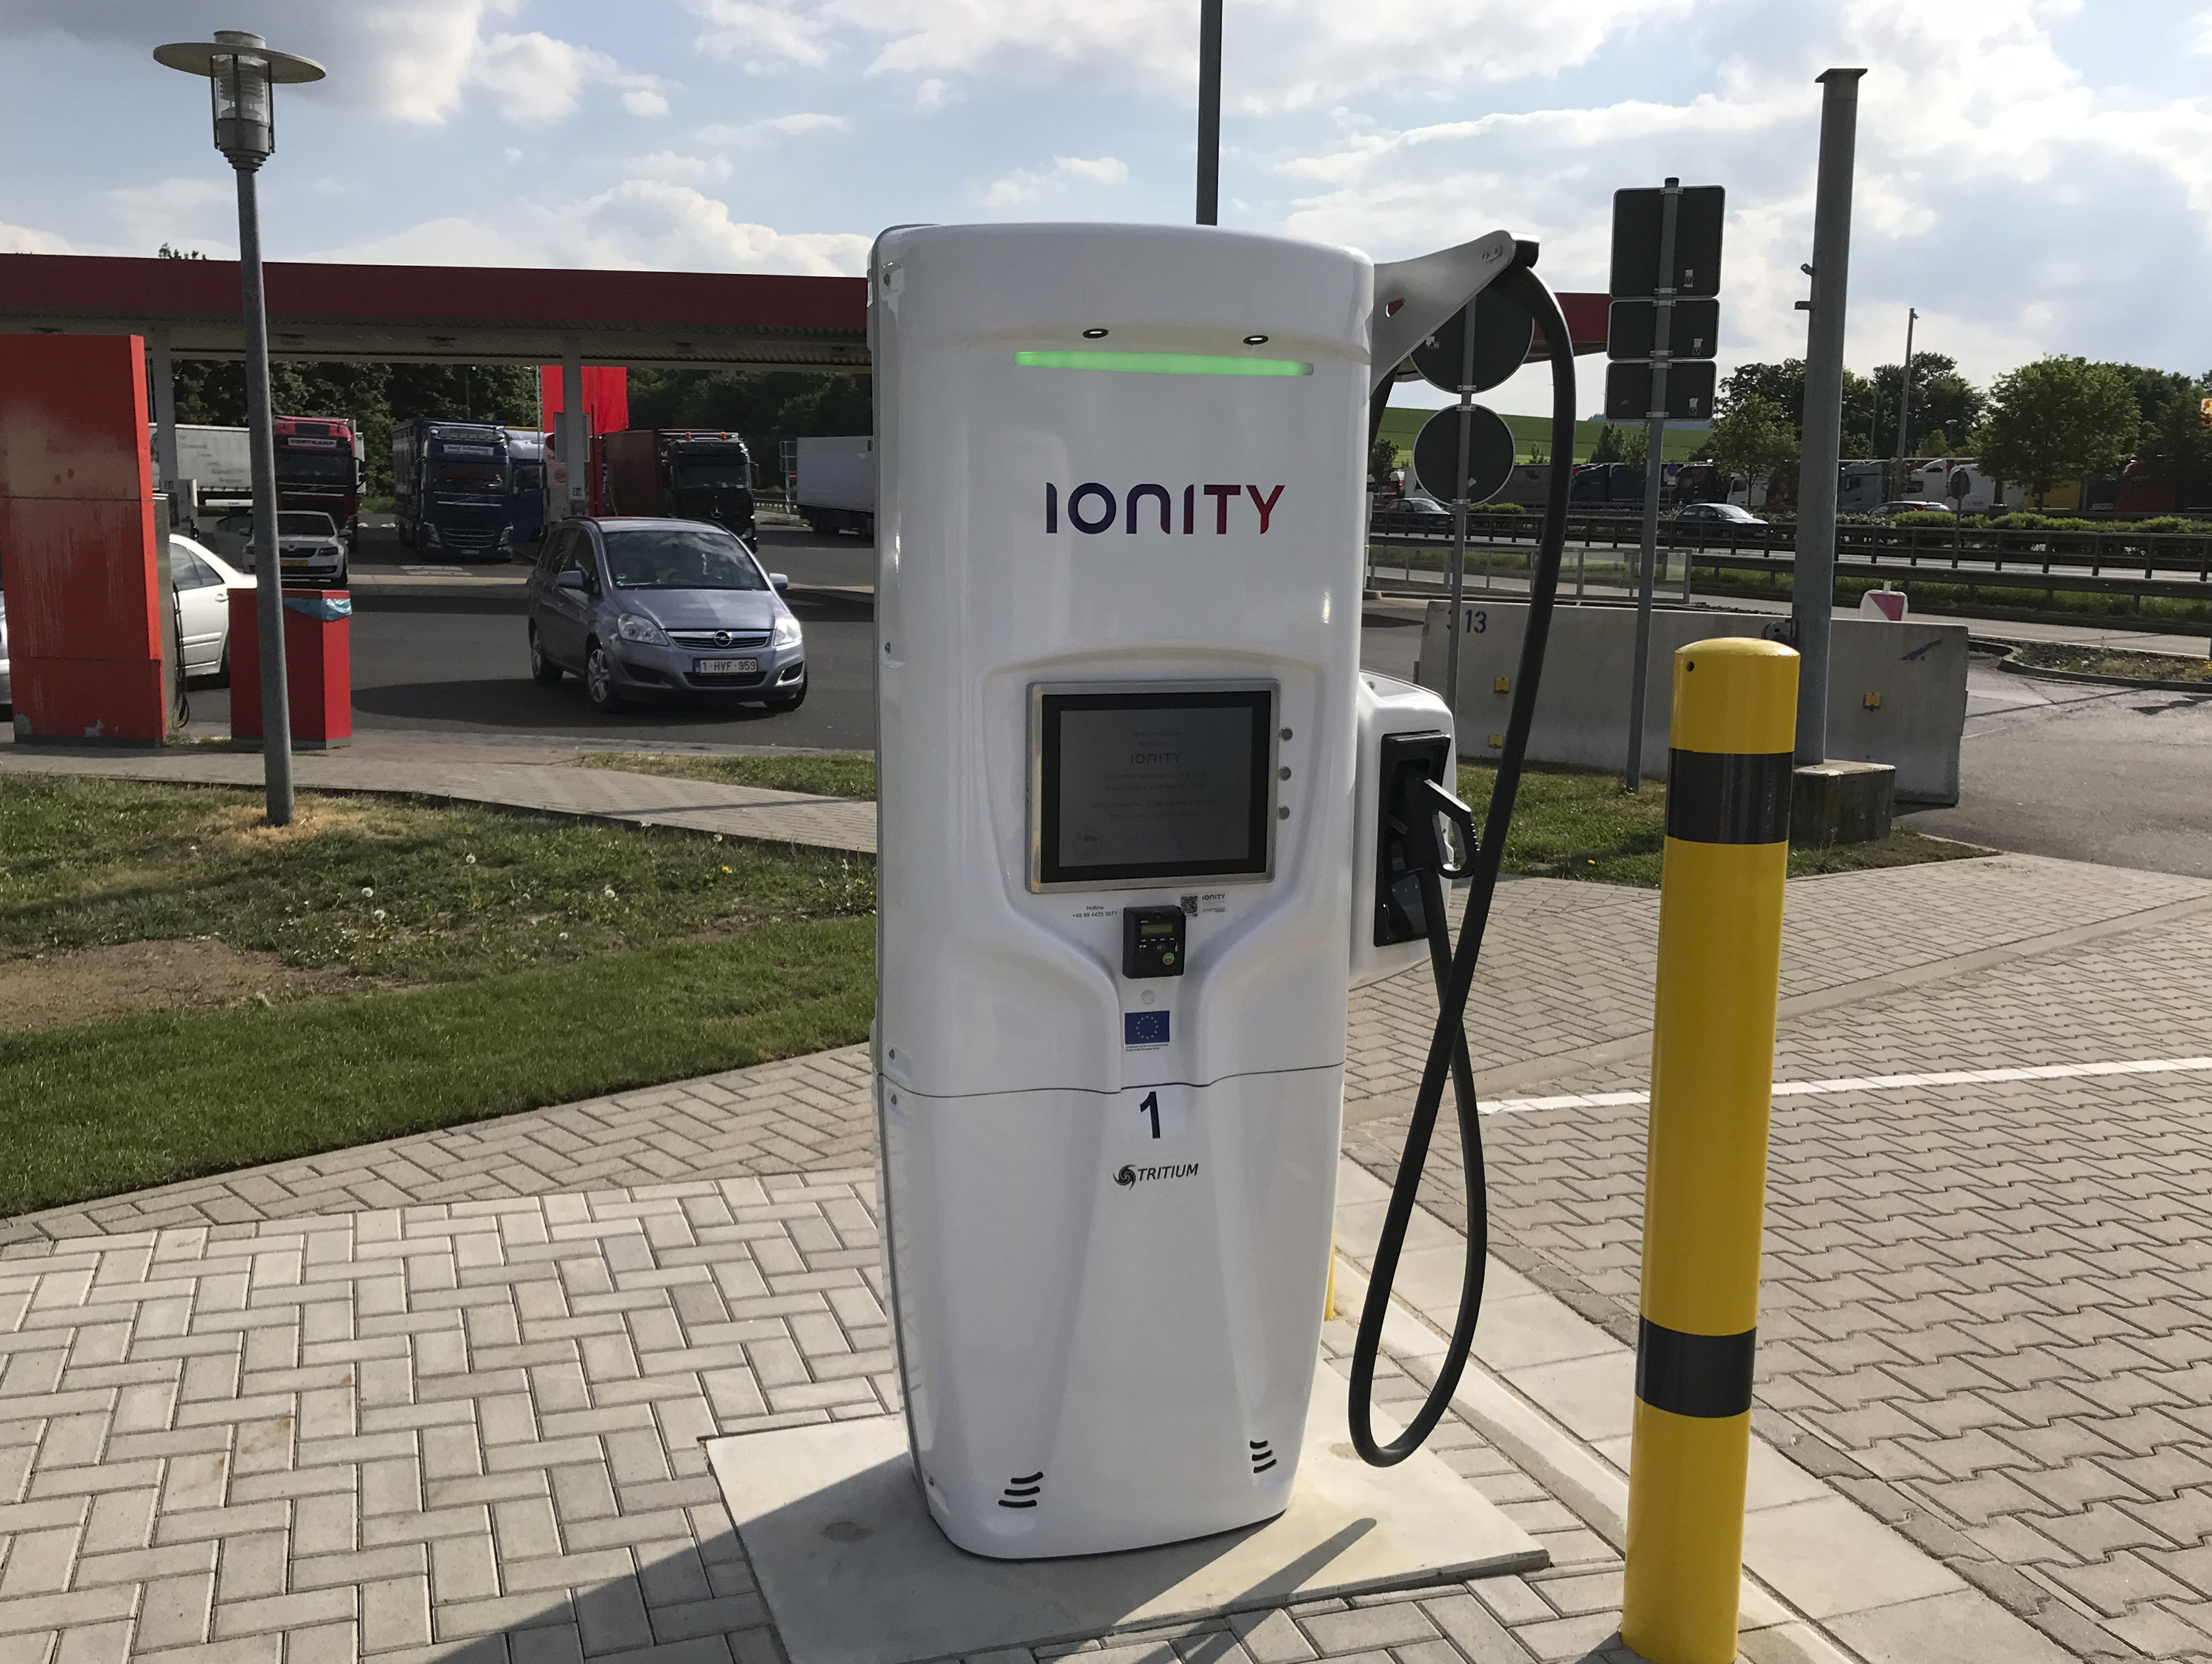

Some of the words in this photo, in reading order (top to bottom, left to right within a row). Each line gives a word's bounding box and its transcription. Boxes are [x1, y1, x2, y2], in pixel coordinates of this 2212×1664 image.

[1046, 482, 1286, 535] IONITY
[1130, 752, 1183, 765] IONITY
[1139, 1091, 1161, 1139] 1
[1137, 1163, 1199, 1181] TRITIUM
